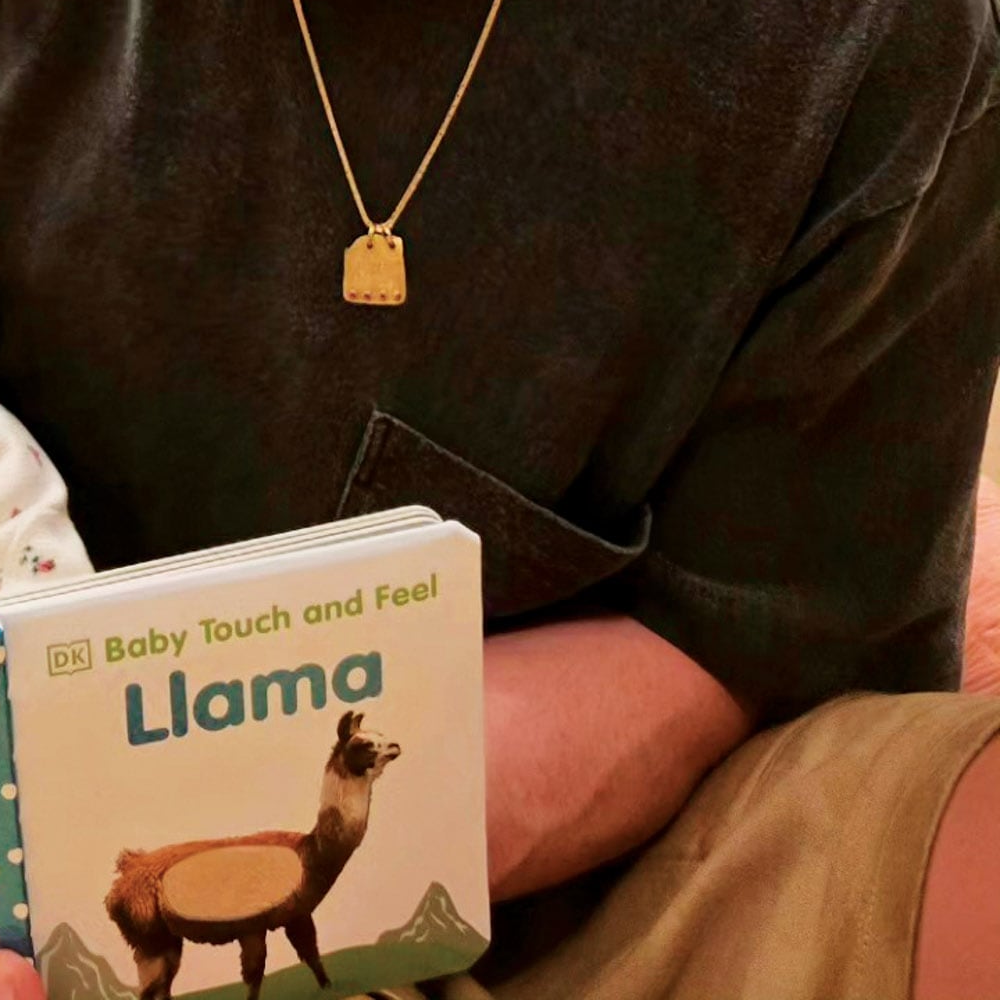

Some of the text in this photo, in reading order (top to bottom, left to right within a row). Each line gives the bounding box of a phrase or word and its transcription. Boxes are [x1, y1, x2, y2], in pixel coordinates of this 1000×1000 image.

[105, 627, 188, 663] Baby
[200, 604, 291, 645] Touch
[302, 588, 364, 626] and
[375, 573, 438, 611] Feel
[124, 650, 383, 747] Llama
